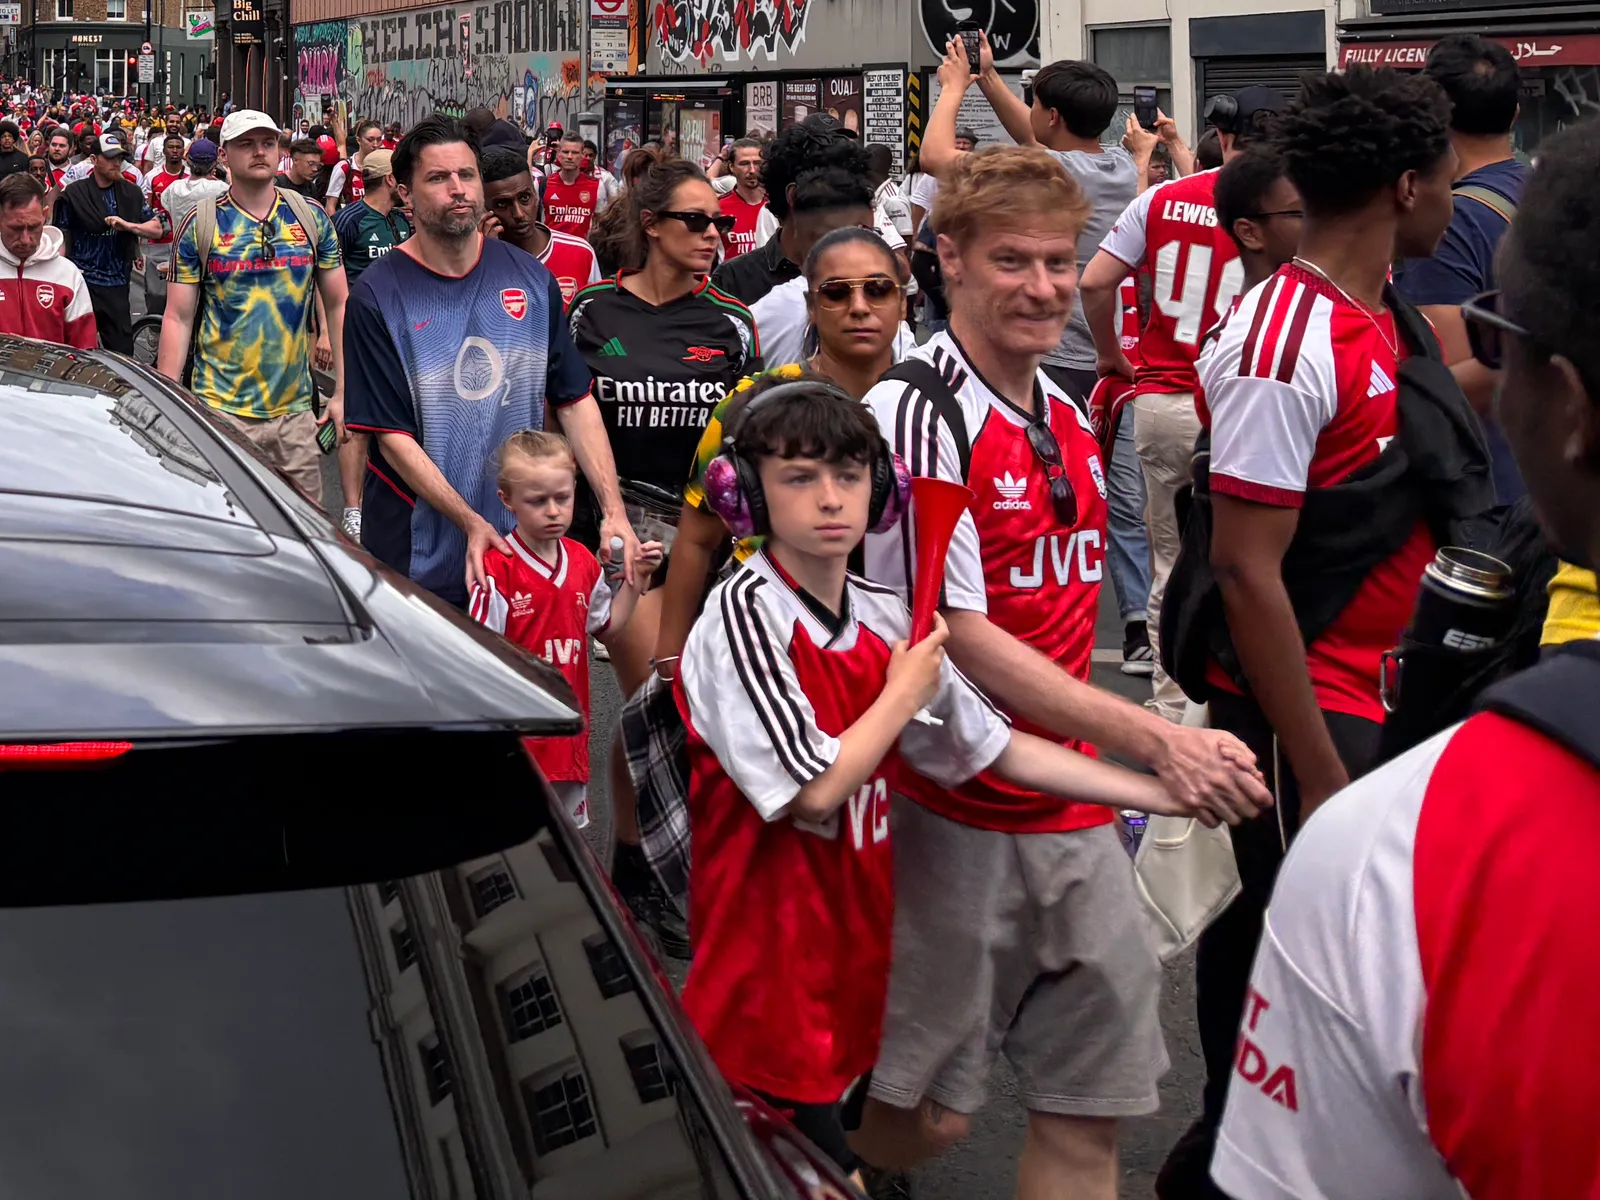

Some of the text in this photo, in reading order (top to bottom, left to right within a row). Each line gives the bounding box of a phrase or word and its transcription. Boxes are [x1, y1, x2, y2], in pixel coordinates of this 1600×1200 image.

[233, 0, 253, 11] Big
[233, 10, 261, 21] Chill
[72, 35, 103, 43] HONEST
[1345, 47, 1382, 64] FULLY
[753, 85, 773, 107] BRB
[549, 204, 591, 216] Emirates
[1162, 200, 1219, 228] LEWIS
[596, 376, 727, 403] Emirates
[617, 406, 710, 428] FLY BETTER
[992, 499, 1032, 510] adidas
[1009, 529, 1103, 588] JVC
